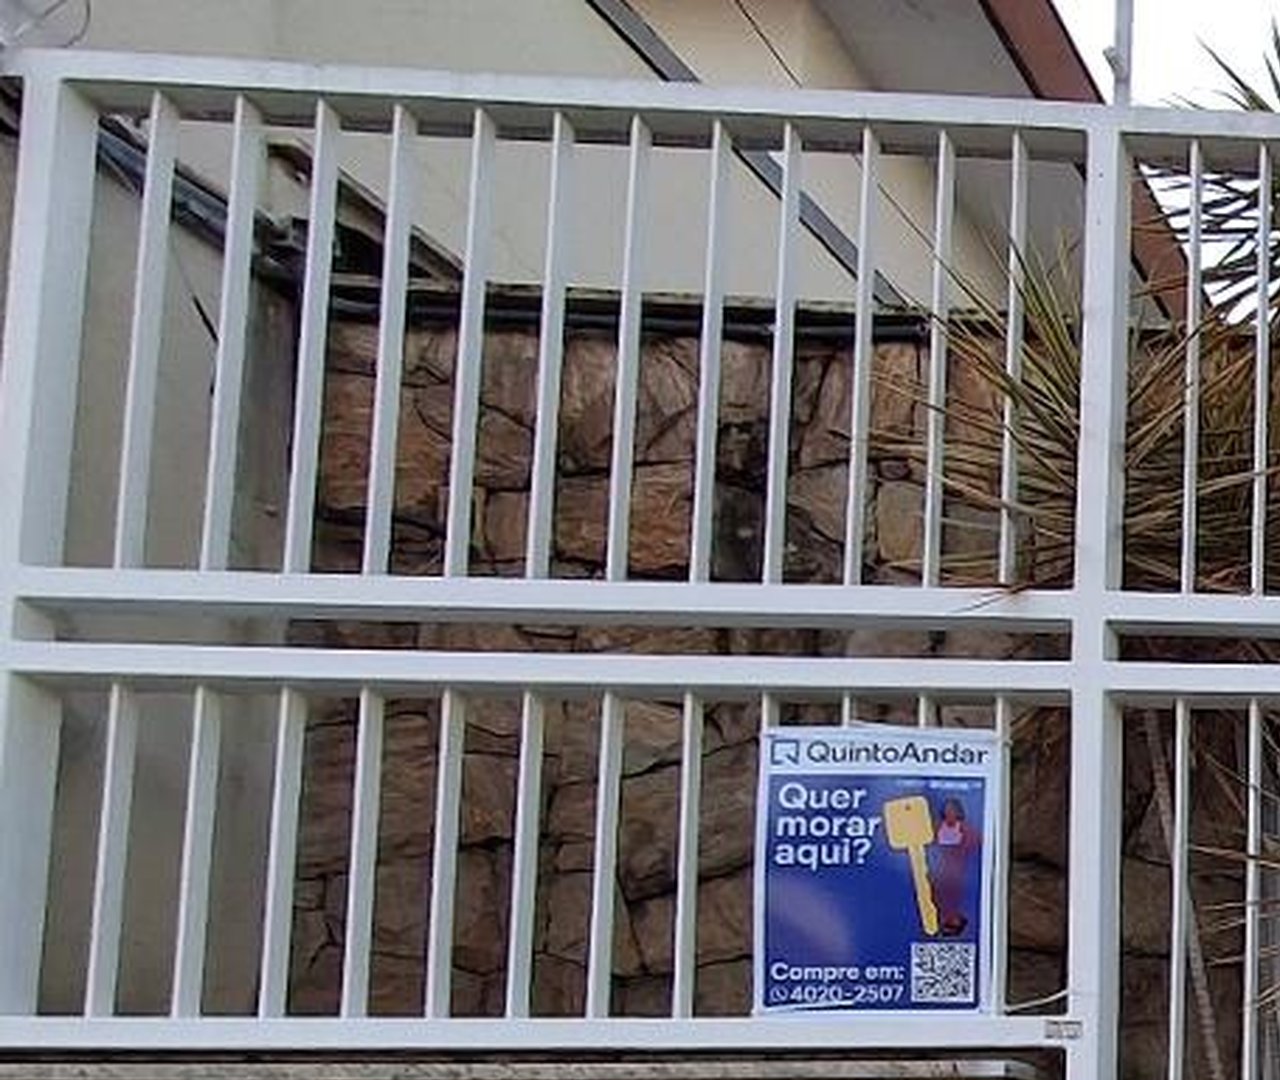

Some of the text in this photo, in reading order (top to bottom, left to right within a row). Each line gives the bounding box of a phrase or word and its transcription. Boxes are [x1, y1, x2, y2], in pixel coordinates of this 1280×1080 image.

[807, 741, 989, 766] QuintoAndar
[779, 783, 867, 809] Quer
[776, 815, 882, 837] morar
[774, 838, 872, 871] aqui?
[770, 962, 860, 983] Compre
[789, 984, 904, 1002] 4020-2507
